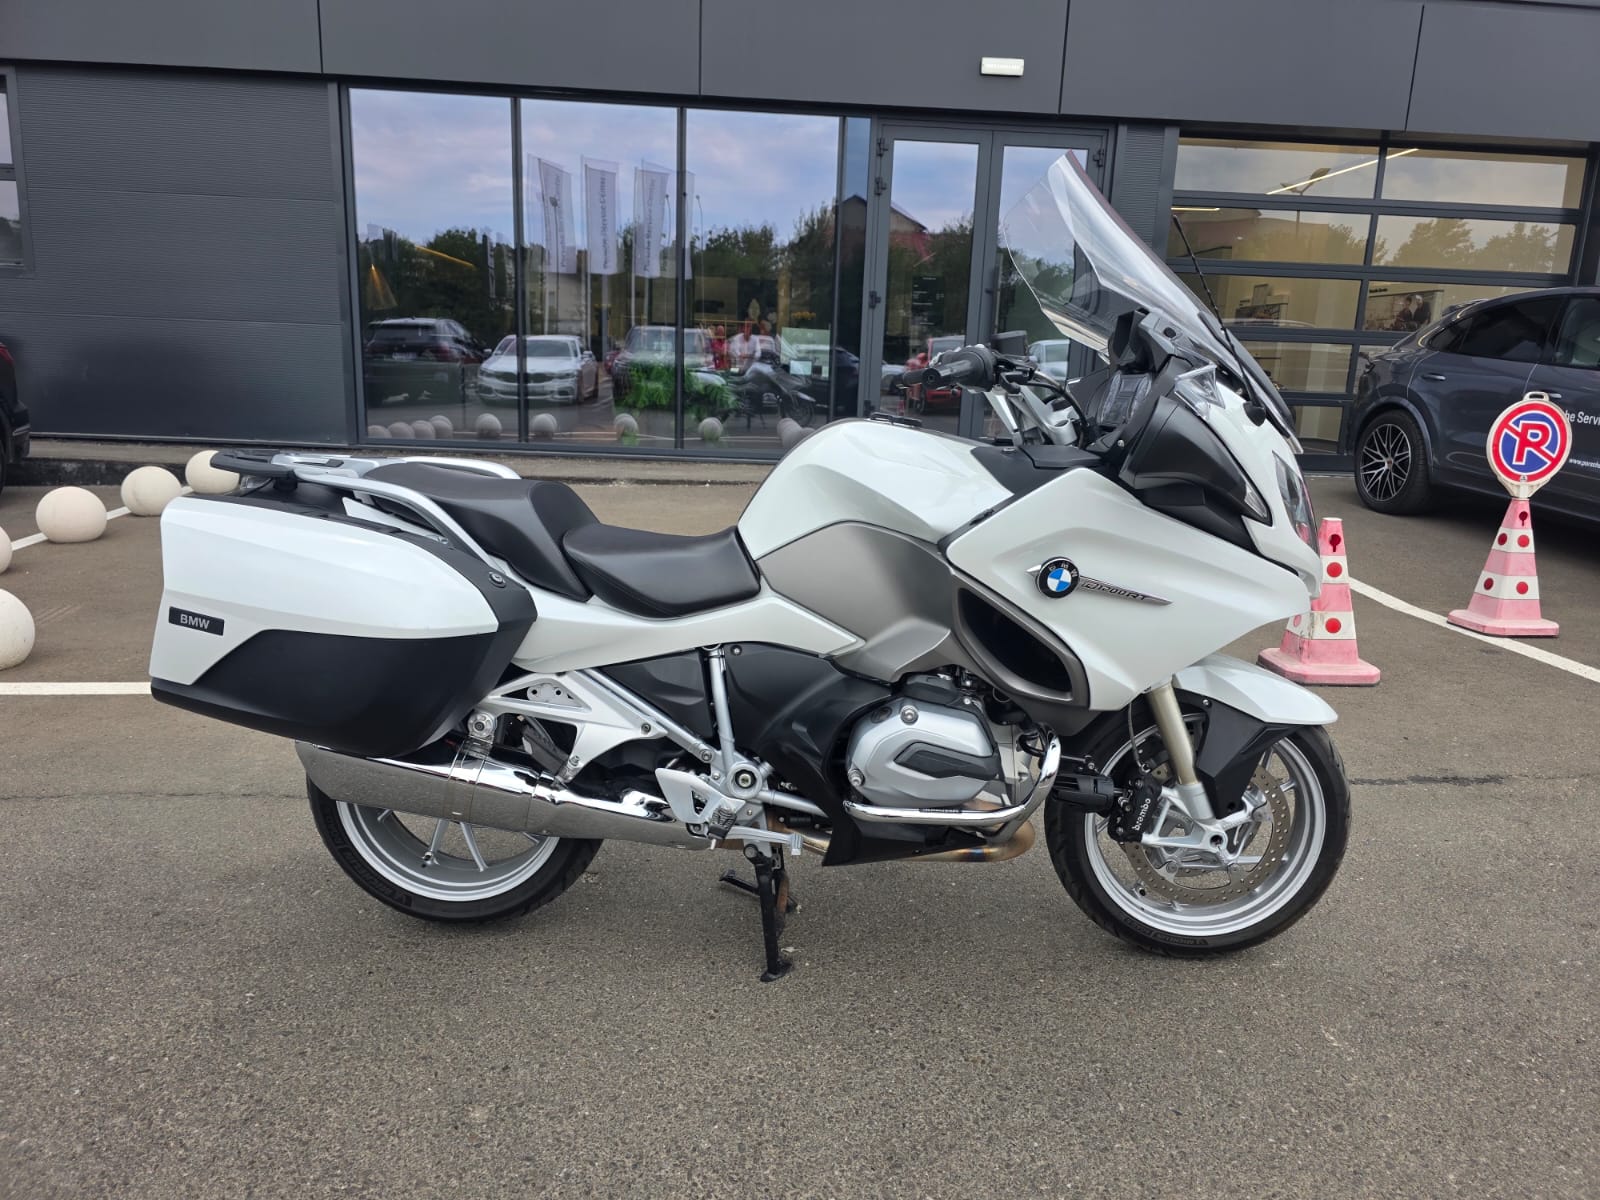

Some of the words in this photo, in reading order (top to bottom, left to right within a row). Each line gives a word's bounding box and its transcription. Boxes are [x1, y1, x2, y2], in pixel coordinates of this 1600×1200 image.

[1048, 562, 1079, 578] BMW
[180, 613, 210, 630] BMW
[1132, 798, 1151, 831] brembo
